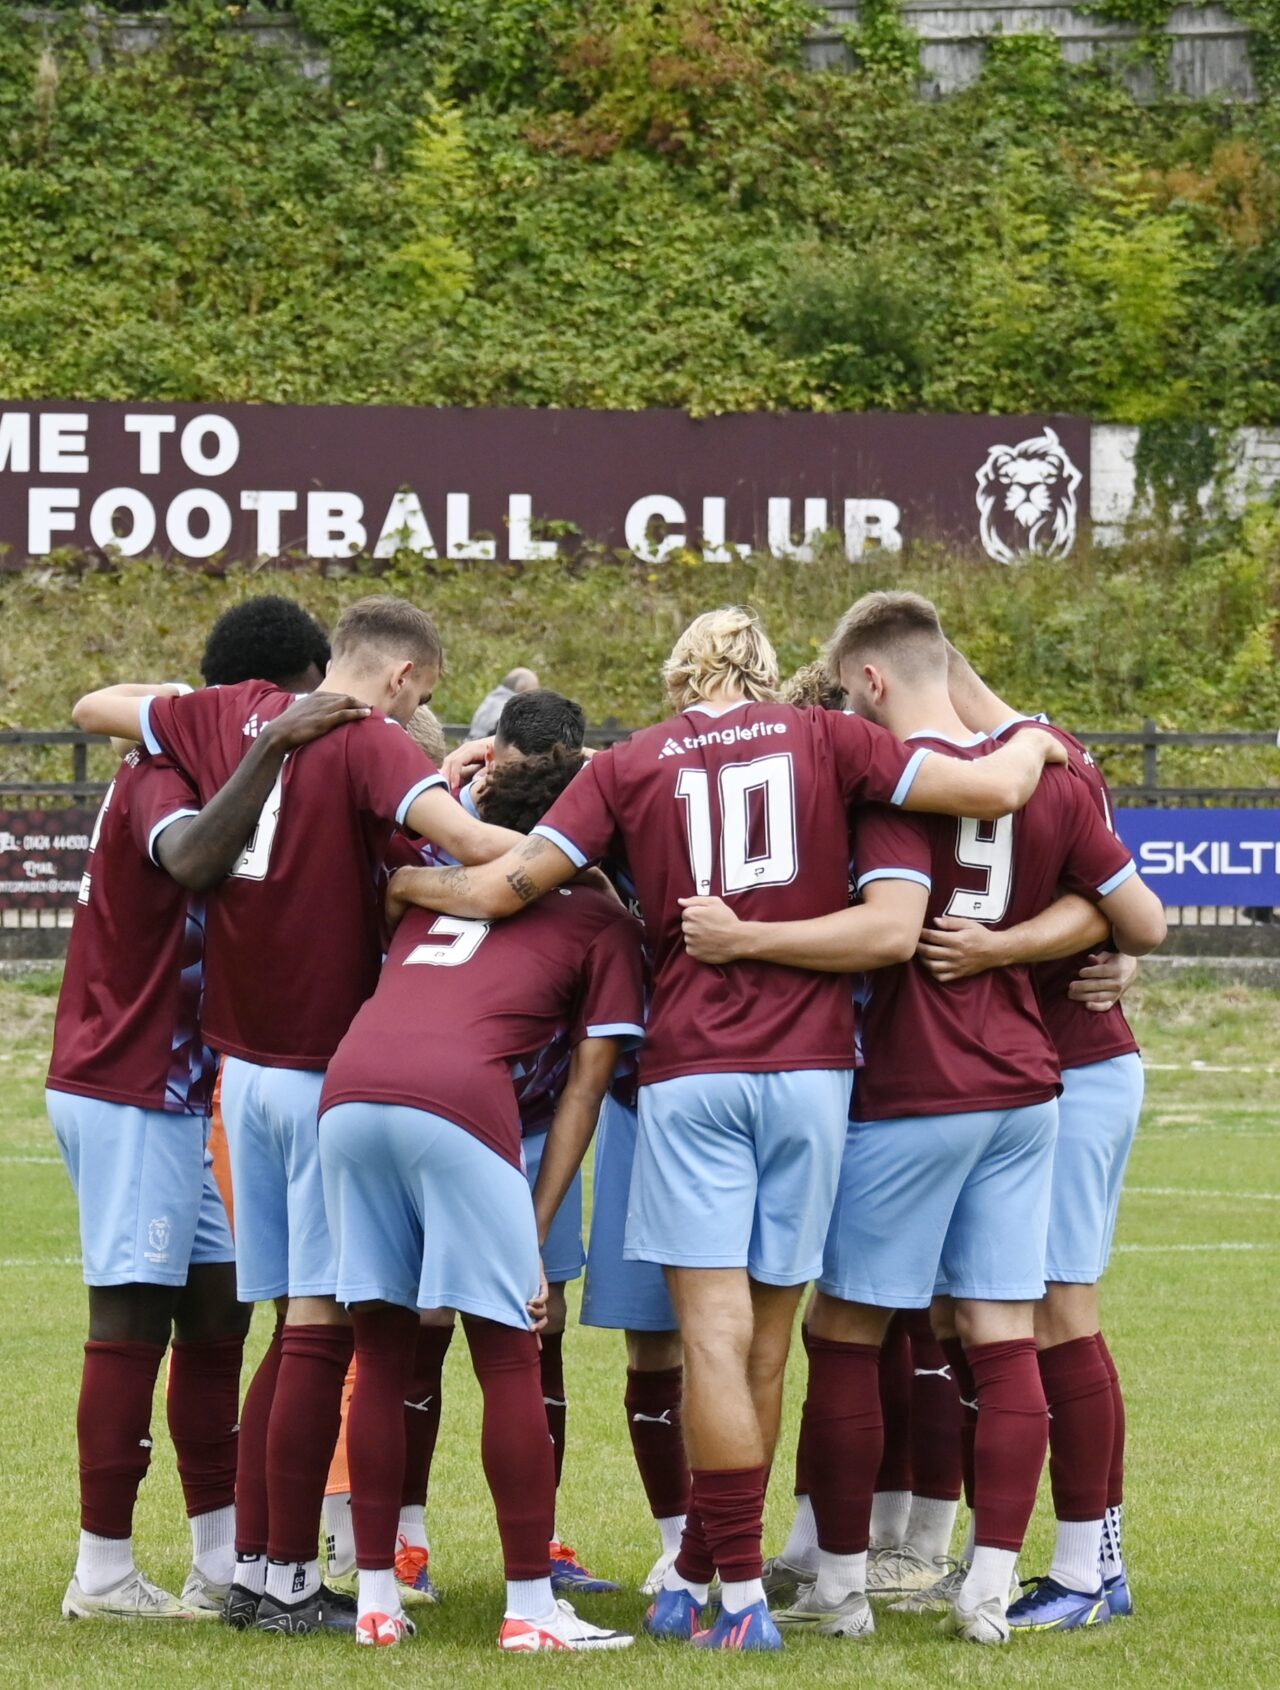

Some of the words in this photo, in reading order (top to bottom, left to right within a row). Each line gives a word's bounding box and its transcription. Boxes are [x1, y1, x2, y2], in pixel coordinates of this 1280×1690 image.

[124, 414, 240, 477] TO
[27, 487, 558, 560] FOOTBALL
[624, 494, 904, 563] CLUB
[674, 752, 799, 896] 10
[1139, 841, 1280, 875] SKILT
[942, 812, 1014, 924] 9
